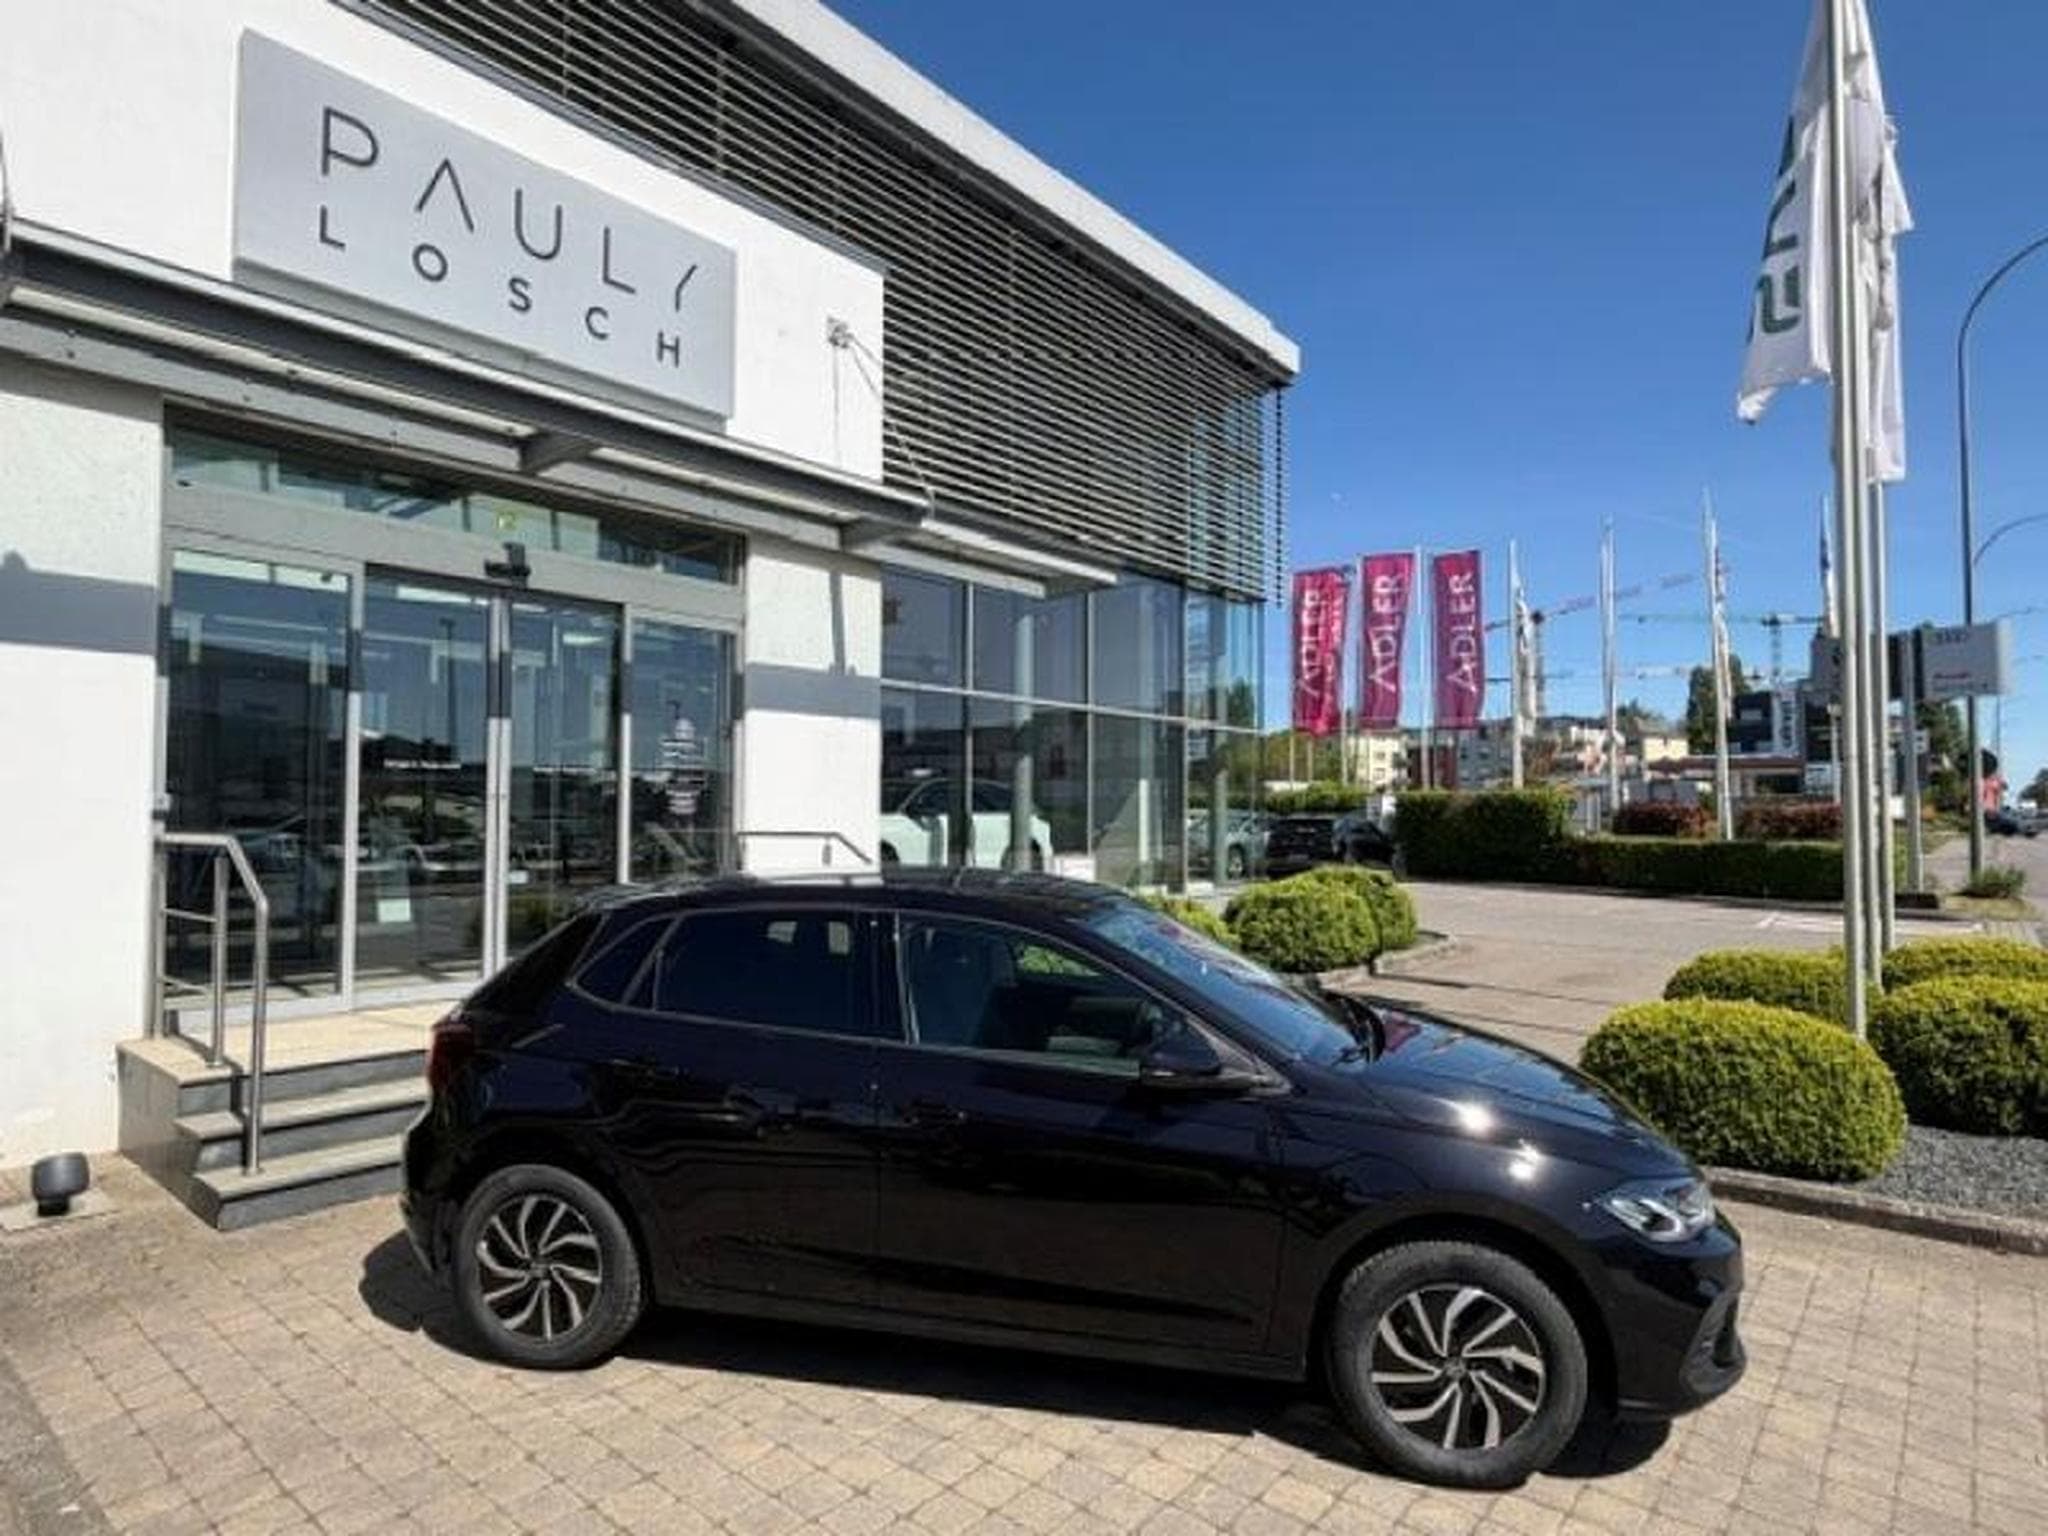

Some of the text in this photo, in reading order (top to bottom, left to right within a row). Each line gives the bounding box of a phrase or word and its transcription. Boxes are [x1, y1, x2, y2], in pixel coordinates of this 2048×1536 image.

[318, 203, 682, 368] LOSCH
[1368, 574, 1402, 693] ADLER
[1446, 570, 1478, 693] ADLER
